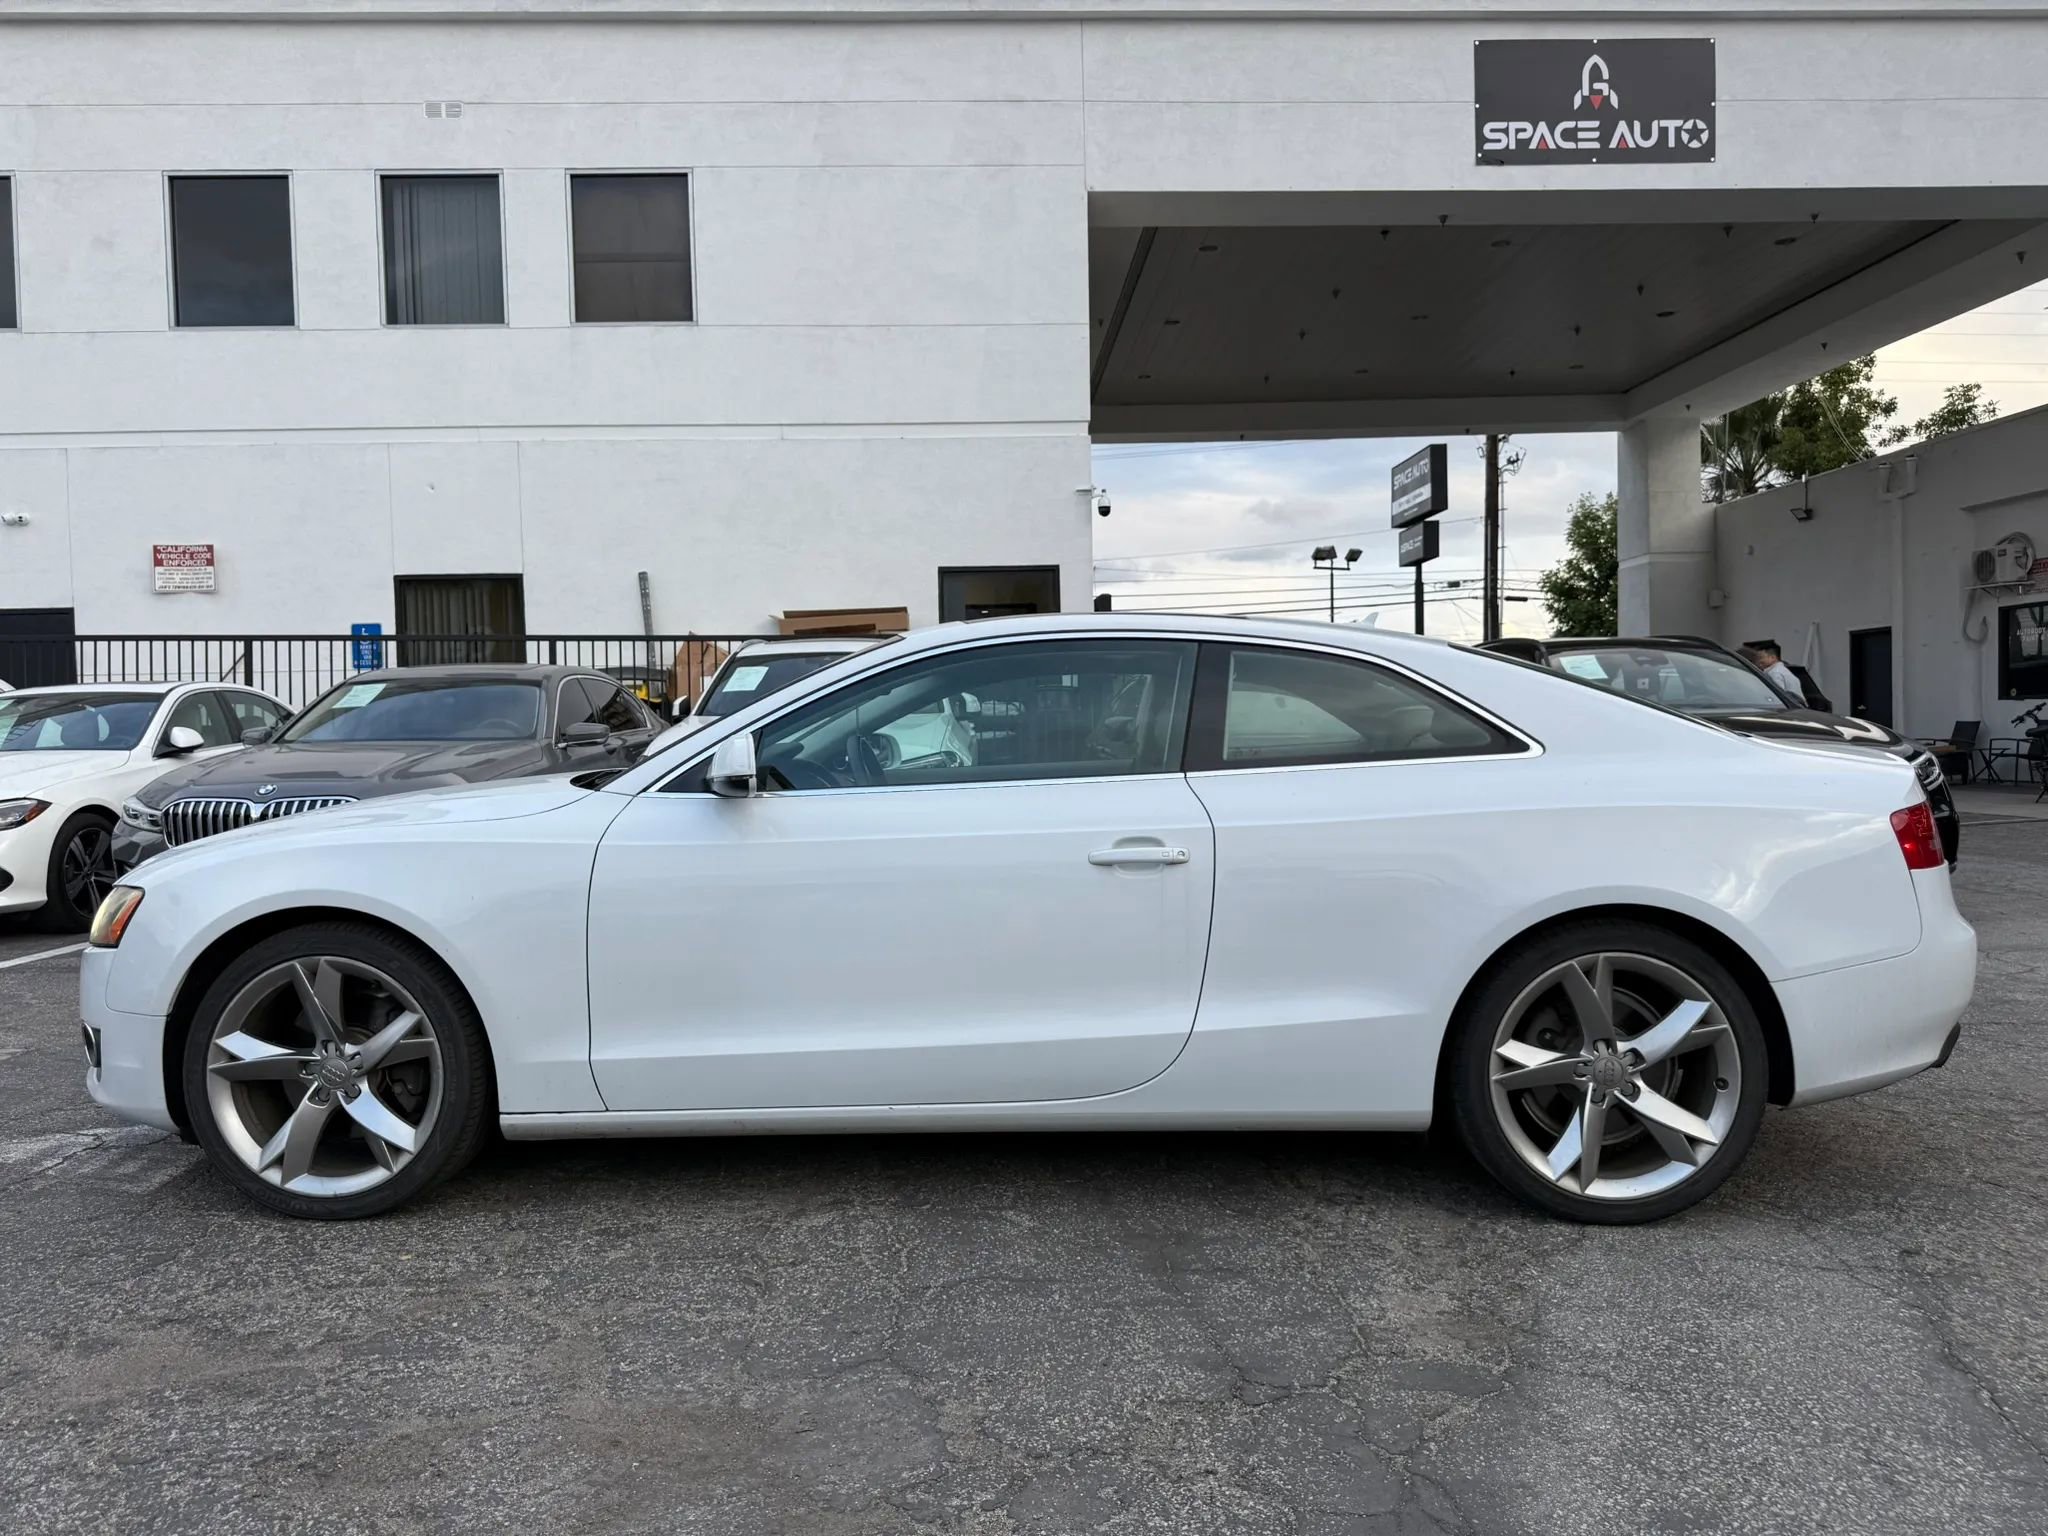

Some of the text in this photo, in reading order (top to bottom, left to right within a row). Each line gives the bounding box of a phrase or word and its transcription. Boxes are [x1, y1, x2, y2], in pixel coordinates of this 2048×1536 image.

[1483, 119, 1709, 150] SPACE AUTO
[1393, 467, 1413, 491] SPACE
